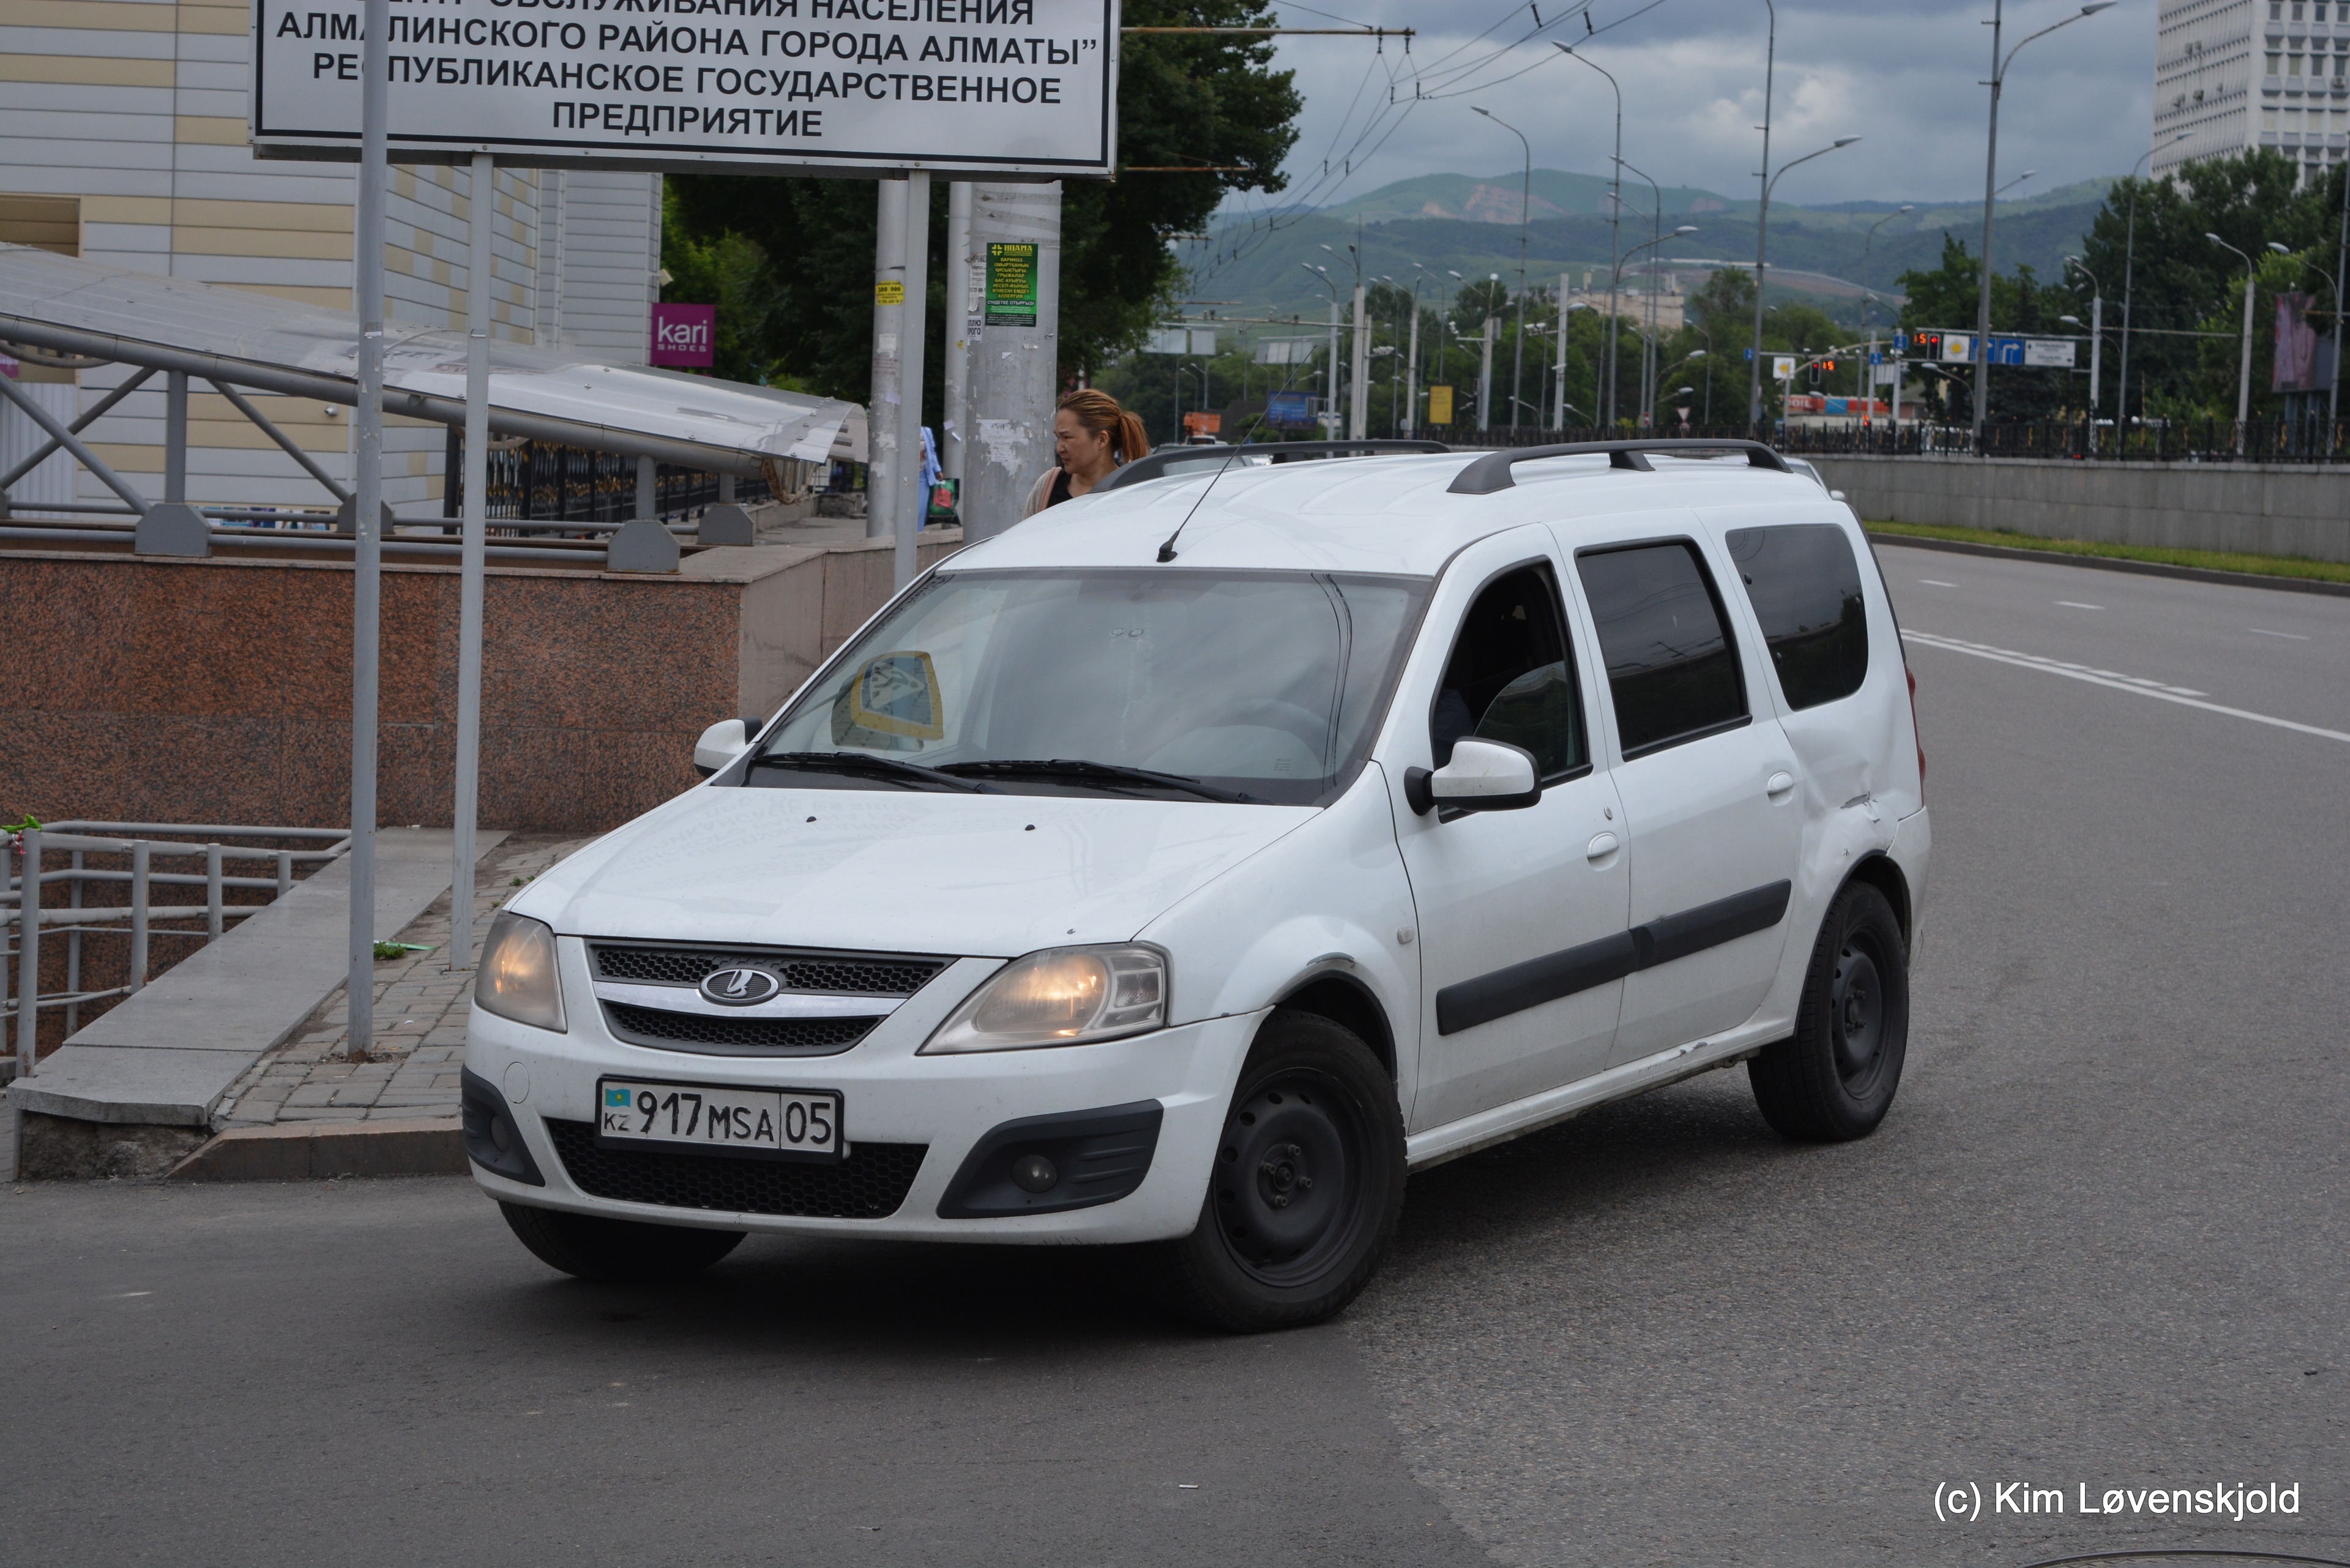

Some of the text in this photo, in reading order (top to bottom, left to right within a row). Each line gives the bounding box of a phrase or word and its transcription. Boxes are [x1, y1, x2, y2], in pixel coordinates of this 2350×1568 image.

[811, 0, 1033, 25] НАСЕЛЕНИЯ
[276, 12, 586, 50] АЛМЛИНСКОГО
[599, 20, 749, 56] РАЙОНА
[762, 30, 909, 65] ГОРОДА
[313, 53, 1061, 104] РЕПУБЛИКАНСКОЕ ГОСУДАРСТВЕННОЕ
[553, 102, 822, 137] ПРЕДПРИЯТИЕ
[657, 316, 707, 344] kari
[603, 1112, 631, 1132] KZ
